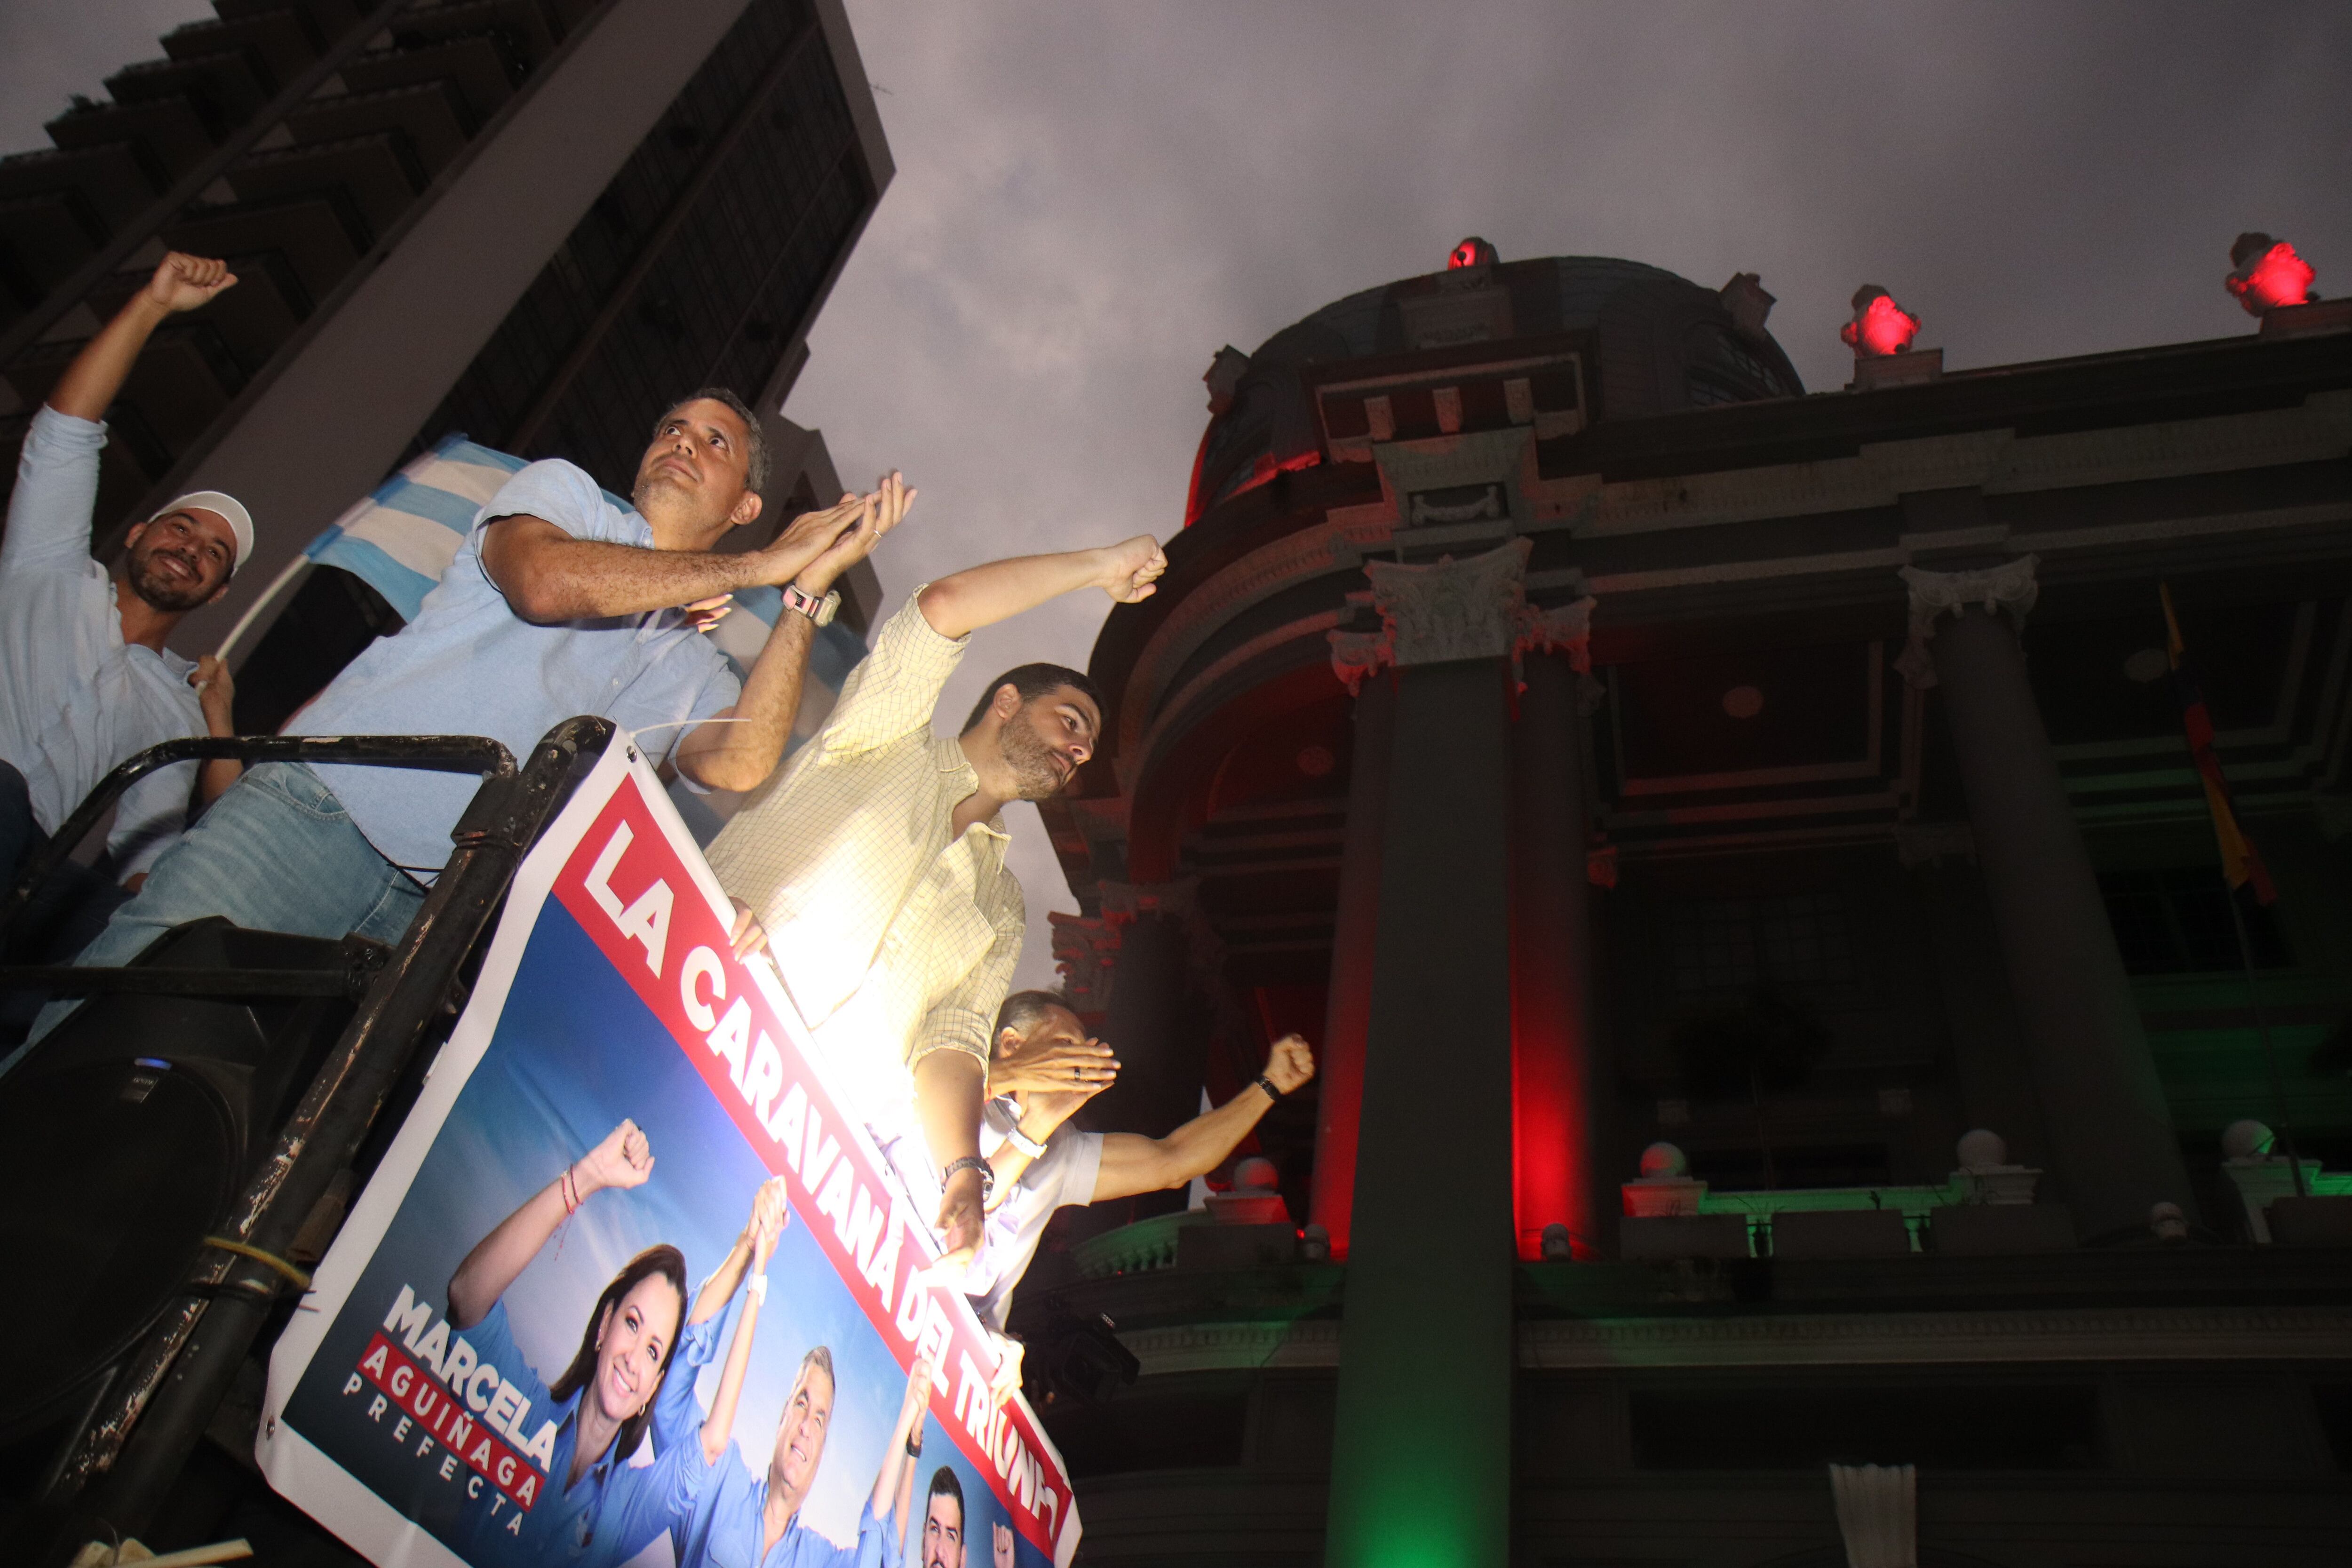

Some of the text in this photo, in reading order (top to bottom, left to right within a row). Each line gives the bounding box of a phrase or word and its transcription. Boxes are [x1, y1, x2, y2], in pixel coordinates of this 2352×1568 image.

[584, 820, 674, 979] LA
[681, 946, 904, 1312] CARAVANA
[897, 1267, 954, 1396] DEL
[343, 1372, 523, 1536] PREFECTA
[364, 1345, 536, 1506] AGUIÑAGA
[383, 1283, 557, 1472] MARCELA
